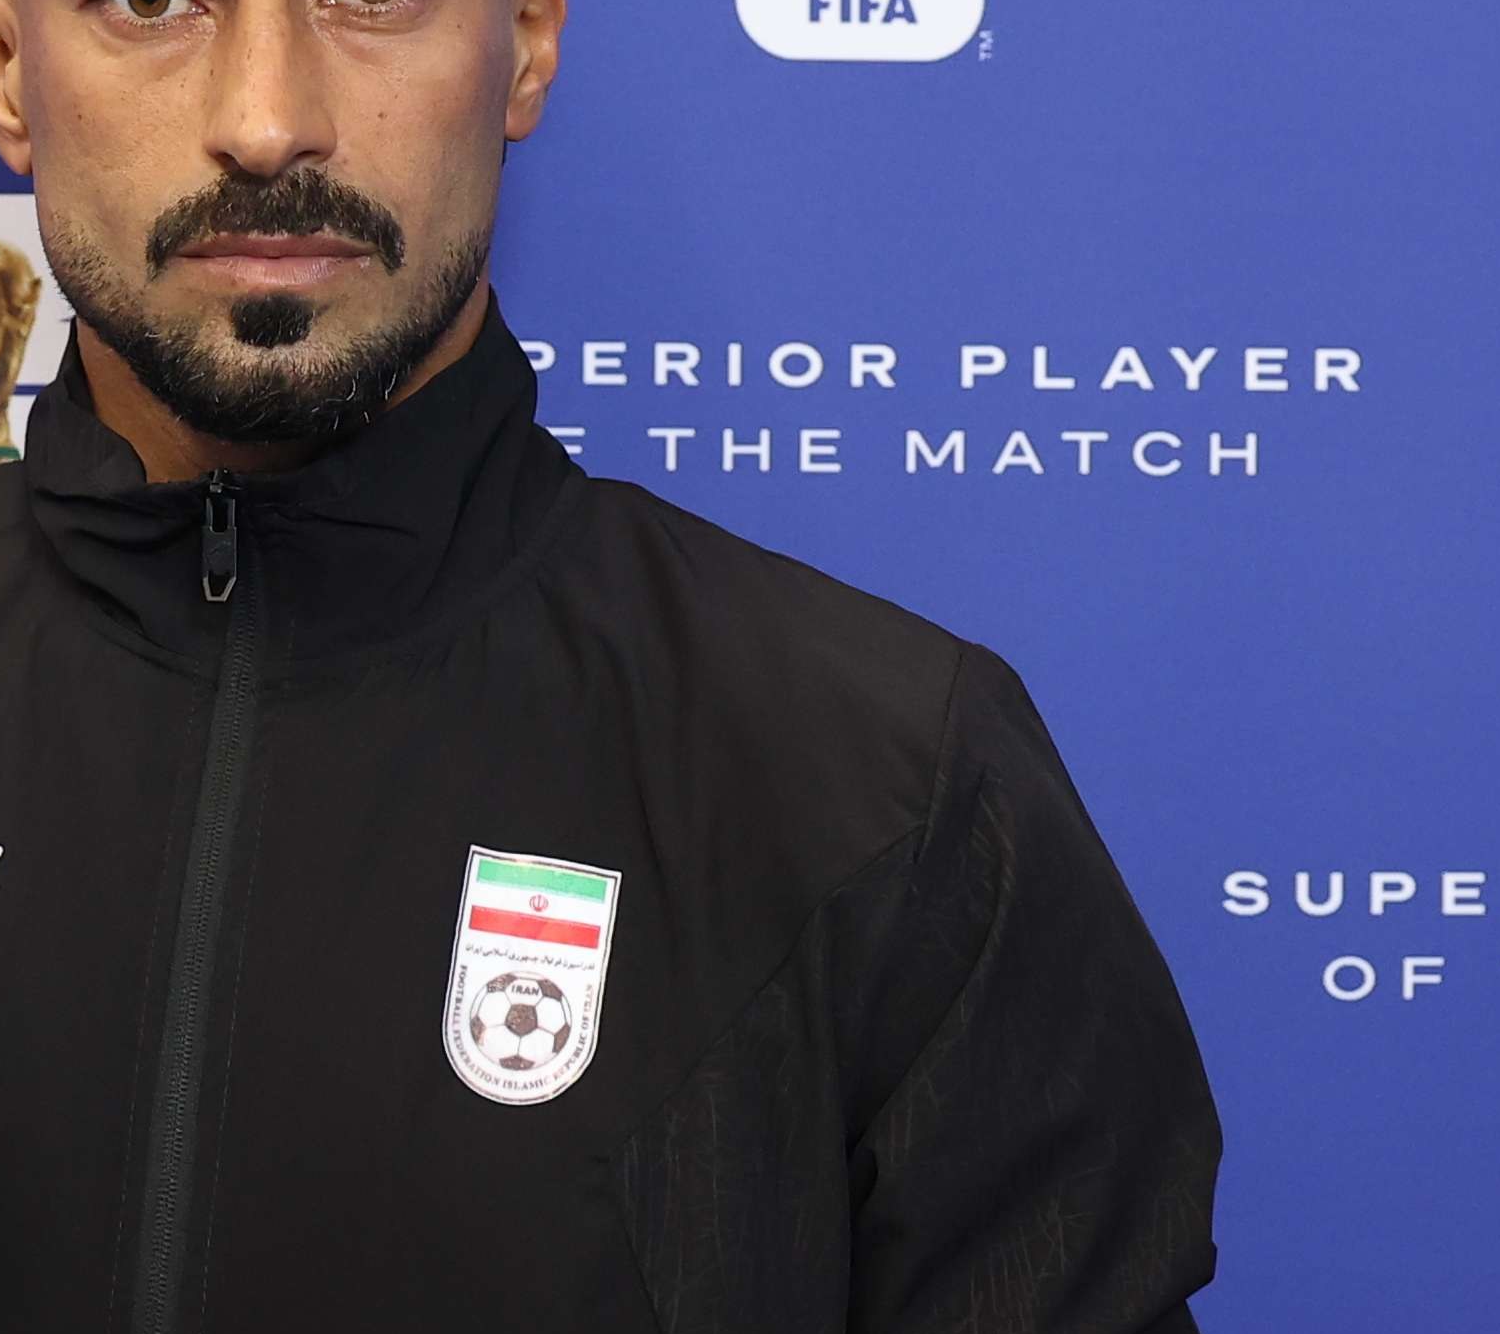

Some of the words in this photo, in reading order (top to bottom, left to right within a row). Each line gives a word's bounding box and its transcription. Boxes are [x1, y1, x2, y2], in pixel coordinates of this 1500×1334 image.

[517, 339, 898, 389] PERIOR
[960, 344, 1362, 393] PLAYER
[646, 427, 843, 474] THE
[905, 429, 1258, 477] MATCH
[511, 984, 540, 996] IRAN
[1322, 955, 1446, 1002] OF
